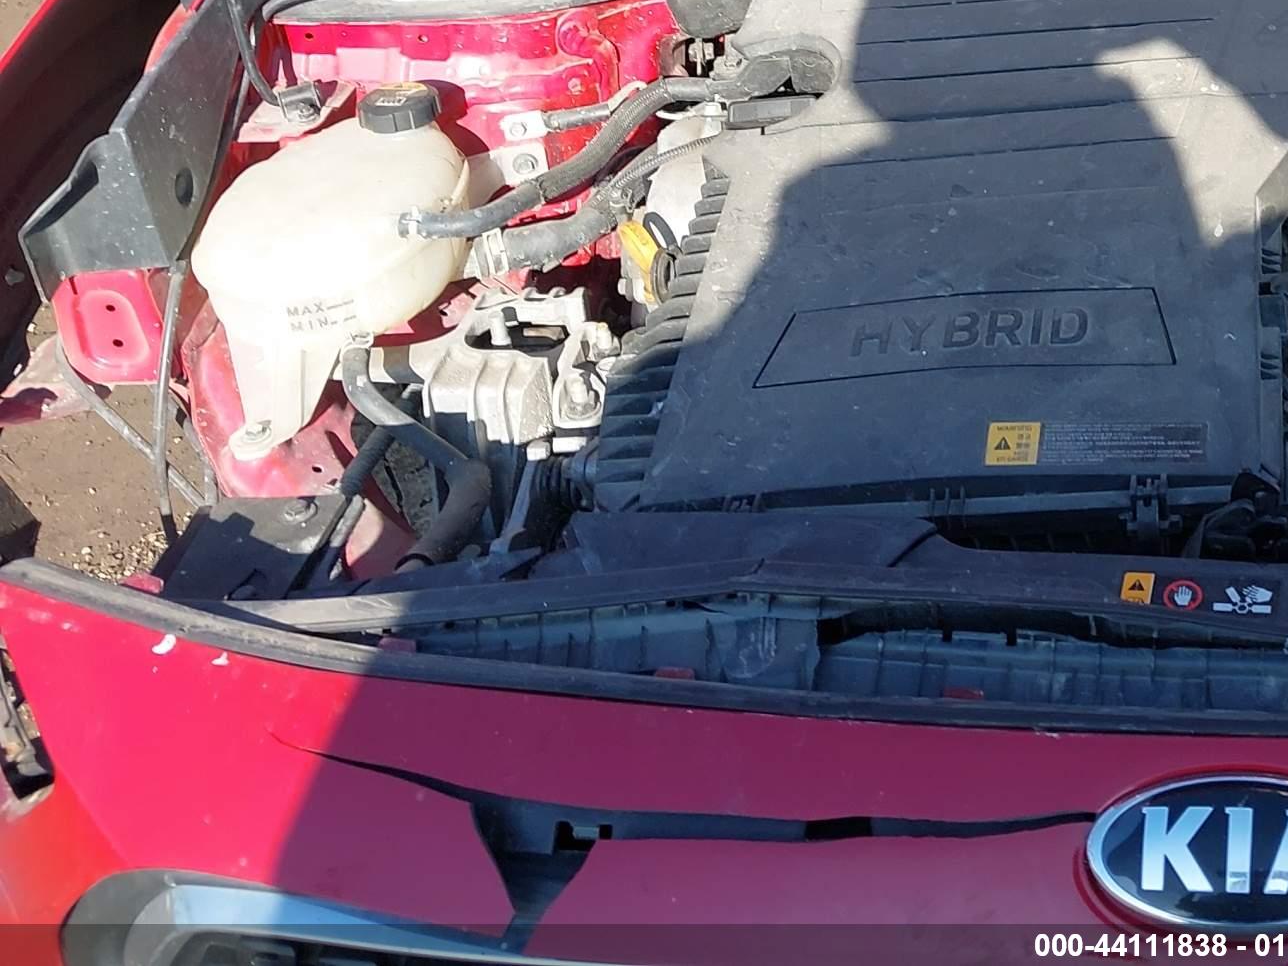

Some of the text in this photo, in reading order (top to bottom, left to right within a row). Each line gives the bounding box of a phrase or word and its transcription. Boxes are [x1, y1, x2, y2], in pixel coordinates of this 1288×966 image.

[286, 301, 325, 317] MAX
[290, 316, 328, 331] MIN
[850, 307, 1090, 357] HYBRID
